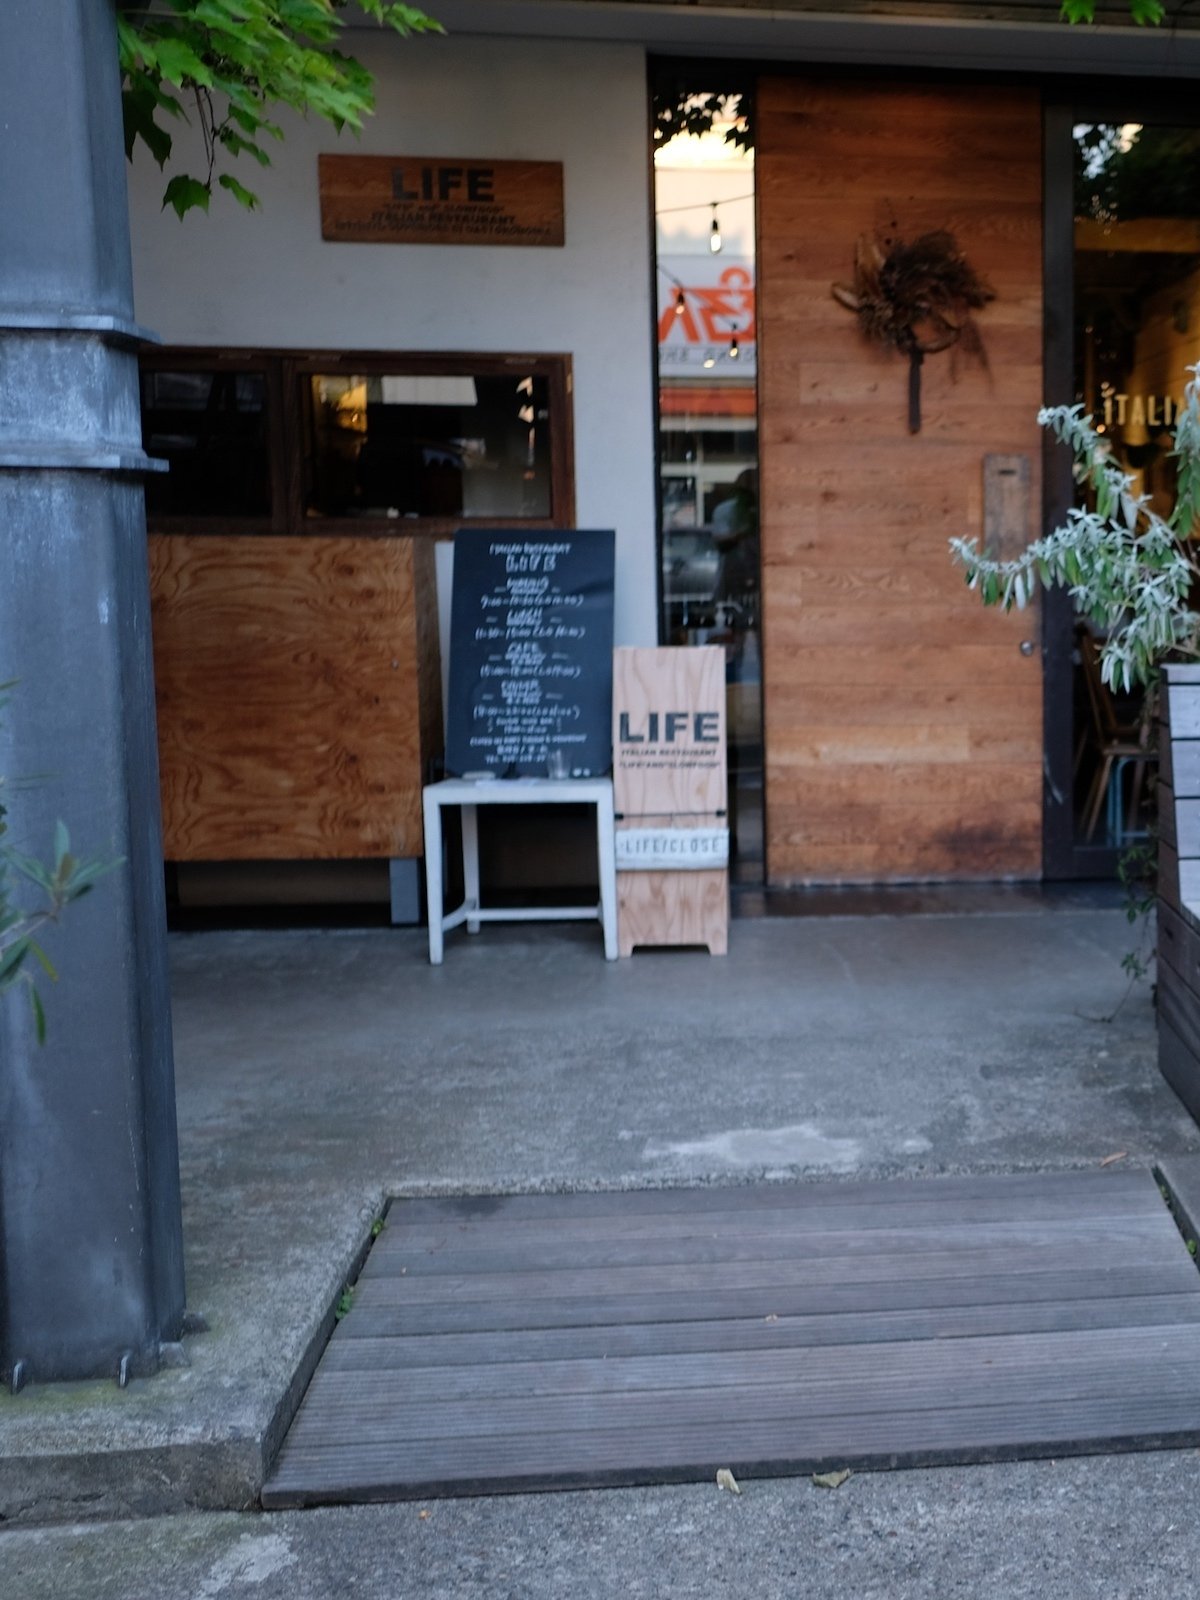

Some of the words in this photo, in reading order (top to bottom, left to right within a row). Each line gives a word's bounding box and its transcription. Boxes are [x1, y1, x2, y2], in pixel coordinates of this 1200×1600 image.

[391, 167, 495, 202] LIFE
[1103, 394, 1188, 427] ITALI
[619, 711, 719, 743] LIFE
